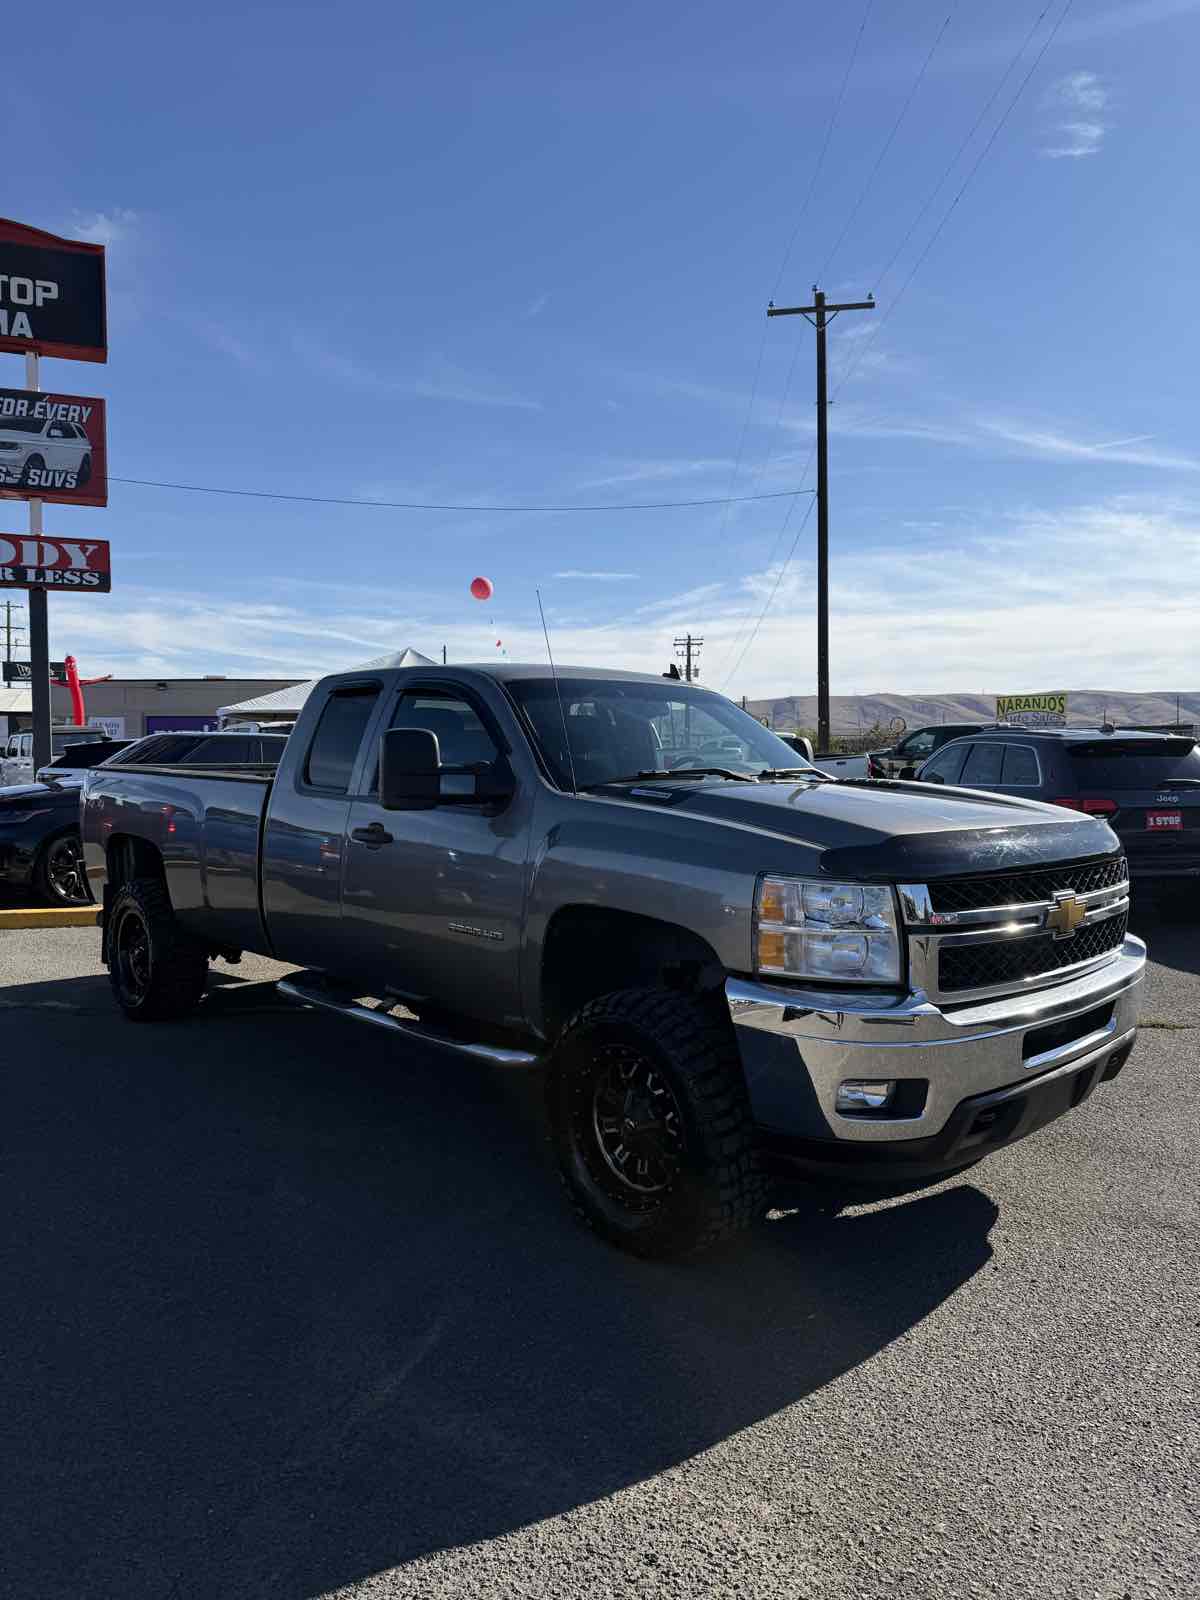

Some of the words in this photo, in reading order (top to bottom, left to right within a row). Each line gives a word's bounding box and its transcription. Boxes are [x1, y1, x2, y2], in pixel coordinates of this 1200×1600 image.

[0, 397, 28, 416] OR
[34, 401, 92, 423] EVERY
[27, 469, 78, 488] SUVS
[26, 568, 100, 585] LESS
[1156, 816, 1181, 826] STOP
